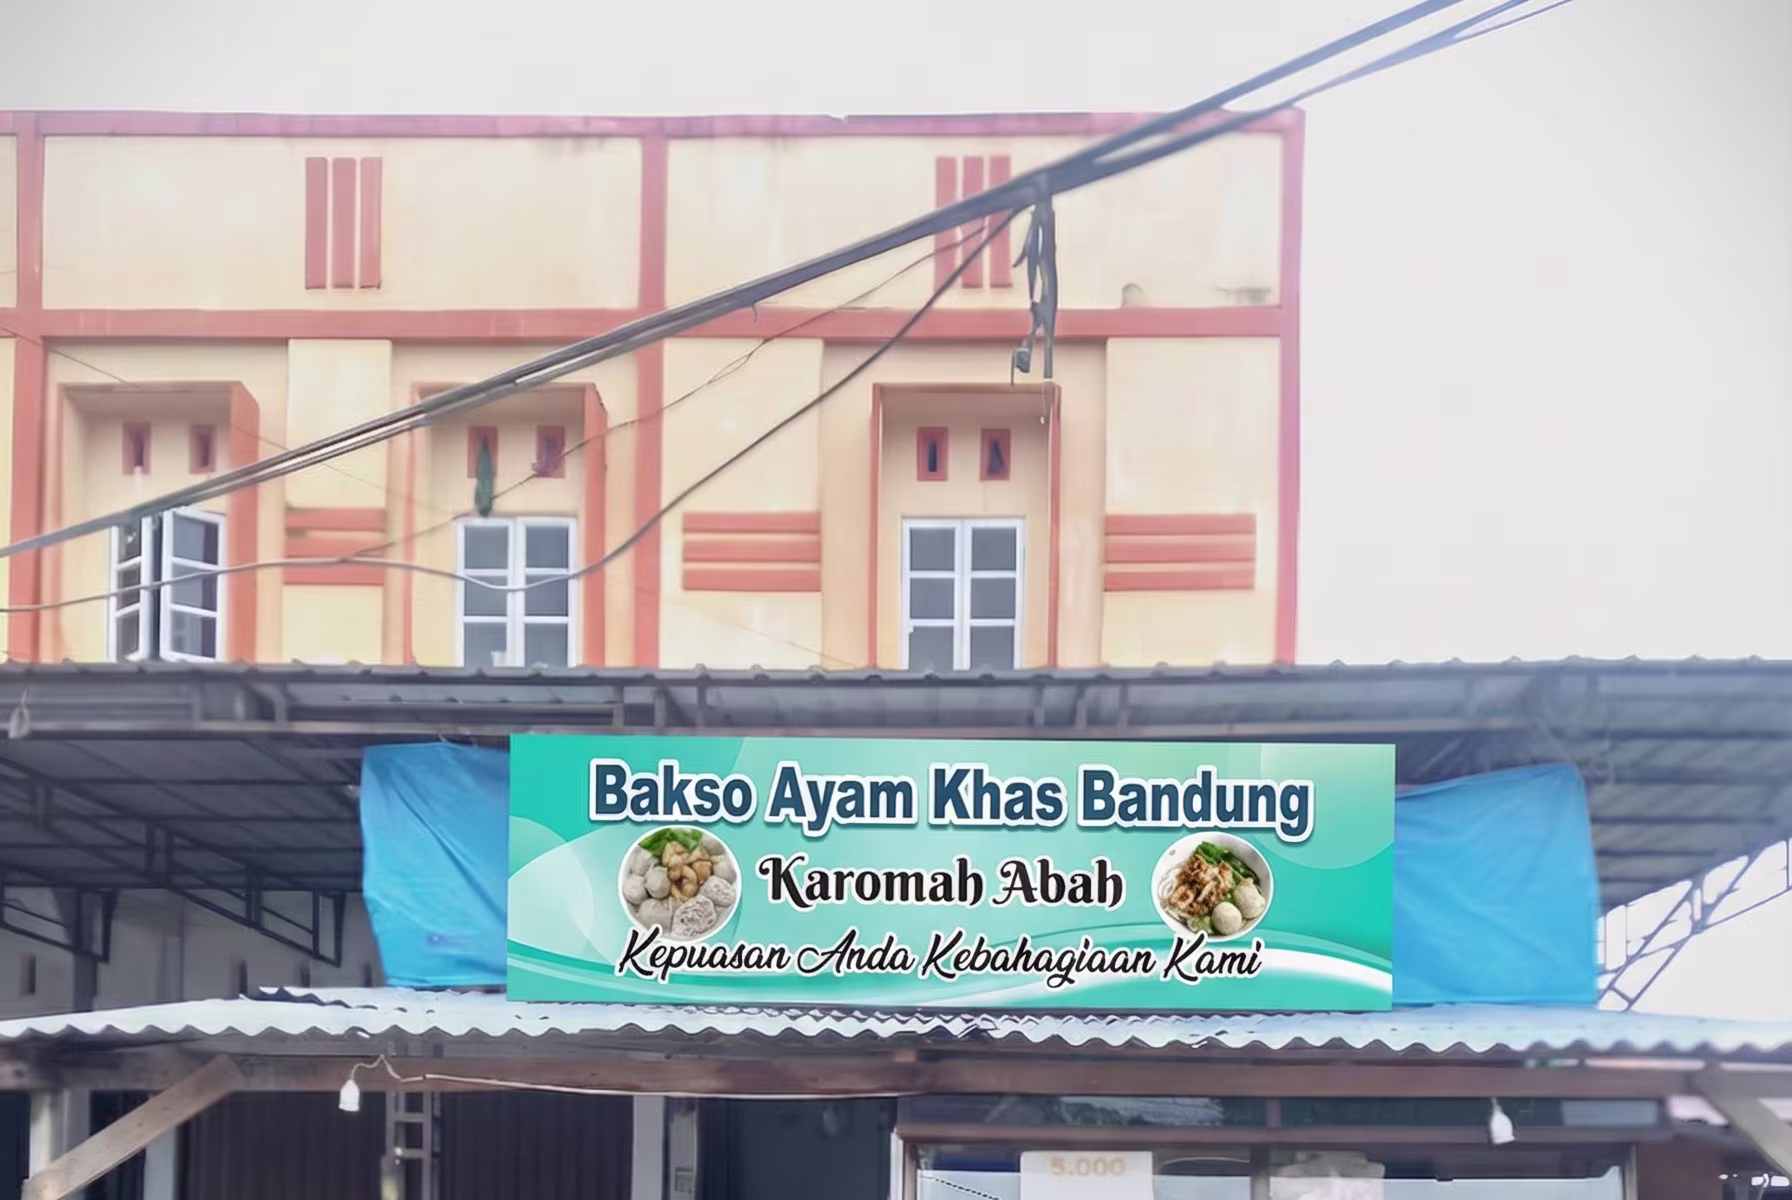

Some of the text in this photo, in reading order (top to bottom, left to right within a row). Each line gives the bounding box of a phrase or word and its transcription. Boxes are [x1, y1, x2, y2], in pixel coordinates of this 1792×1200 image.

[593, 762, 1310, 838] Bakso Ayam Khas Bandung
[758, 857, 1124, 909] Karomah Abah
[618, 927, 1263, 988] Kepuasan Anda Kebahagiaan Kami
[1049, 1156, 1126, 1177] 5.000
